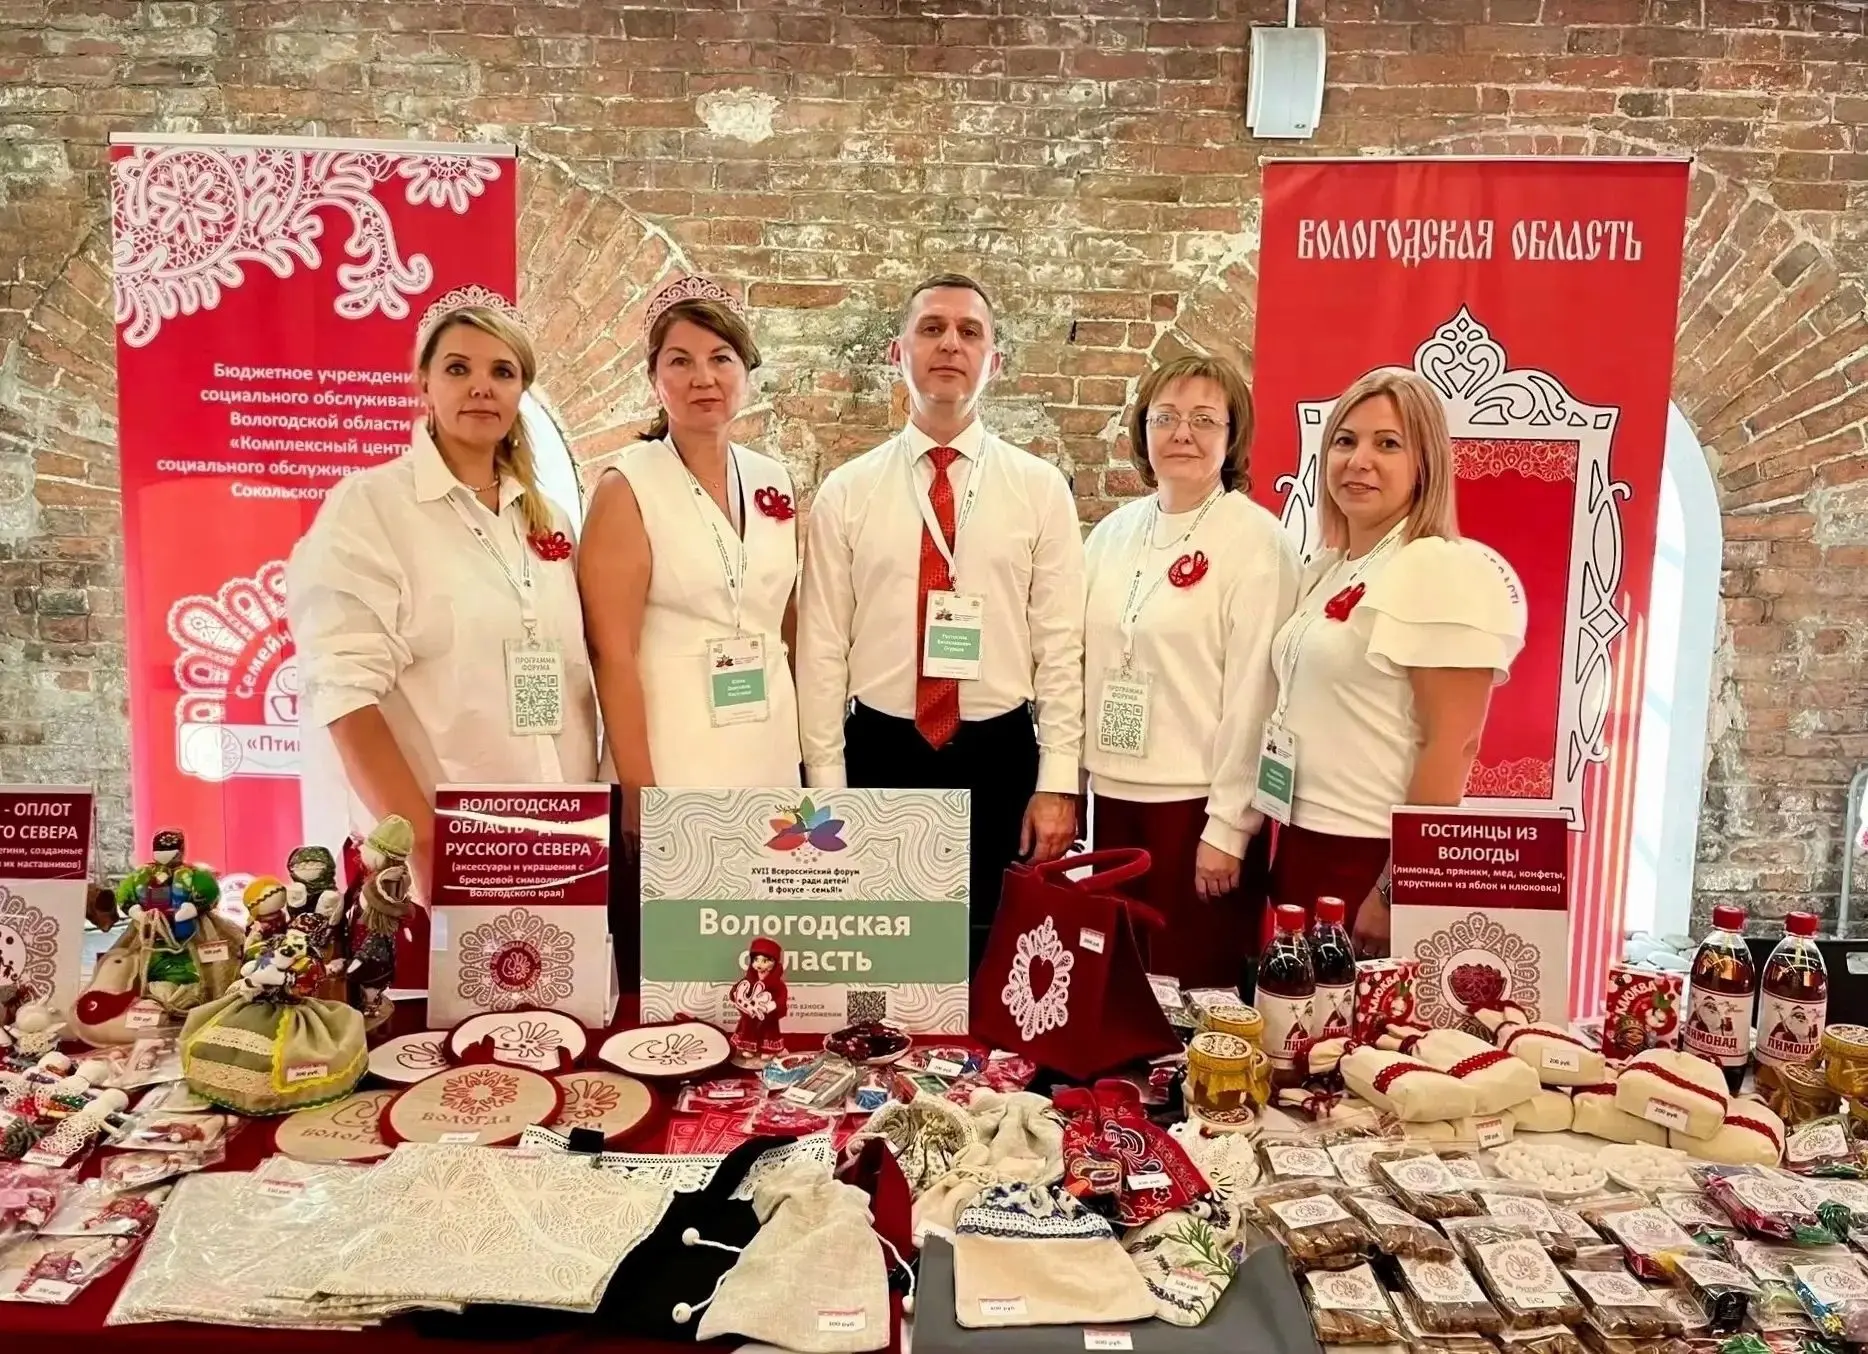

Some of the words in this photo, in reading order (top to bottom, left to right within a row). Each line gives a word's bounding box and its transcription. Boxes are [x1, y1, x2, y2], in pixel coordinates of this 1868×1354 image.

[1297, 218, 1494, 268] ВОЛОГОДСКАЯ
[1511, 219, 1642, 261] ОБЛАСТЬ
[213, 362, 313, 381] Бюджетное
[200, 388, 309, 405] социального
[230, 411, 339, 430] Вологодской
[343, 415, 411, 431] области
[229, 435, 358, 454] «Комплексный
[156, 458, 265, 474] социального
[231, 482, 329, 500] Сокольског
[515, 656, 556, 664] ПРОГРАММА
[14, 802, 72, 816] ОПЛОТ
[459, 799, 580, 814] ВОЛОГОДСКАЯ
[20, 825, 78, 839] СЕВЕРА
[1421, 823, 1511, 842] ГОСТИНЦЫ
[1516, 826, 1538, 840] ИЗ
[30, 847, 83, 856] созданные
[446, 842, 528, 856] РУССКОГО
[532, 842, 591, 856] СЕВЕРА
[1438, 846, 1520, 864] ВОЛОГДЫ
[17, 860, 81, 870] наставников)
[452, 862, 512, 873] (аксессуары
[522, 863, 577, 873] украшения
[751, 867, 769, 875] XVII
[771, 867, 831, 876] Всероссийский
[833, 868, 860, 876] форум
[1393, 865, 1444, 876] (лимонад,
[1446, 868, 1491, 878] пряники,
[1493, 870, 1516, 879] мед,
[1519, 870, 1566, 880] конфеты,
[459, 875, 514, 885] брендовой
[802, 877, 821, 885] ради
[823, 877, 850, 885] детей!
[1398, 880, 1453, 890] «хрустики»
[1468, 881, 1498, 890] яблок
[1508, 883, 1561, 894] клюковка)
[469, 888, 536, 898] Вологодского
[538, 888, 565, 898] края)
[776, 886, 804, 894] фокусе
[699, 908, 911, 940] Вологодская
[738, 949, 873, 972] оласть
[1615, 980, 1658, 1015] КЛЮКВА
[421, 1111, 511, 1126] ВОЛОГДА
